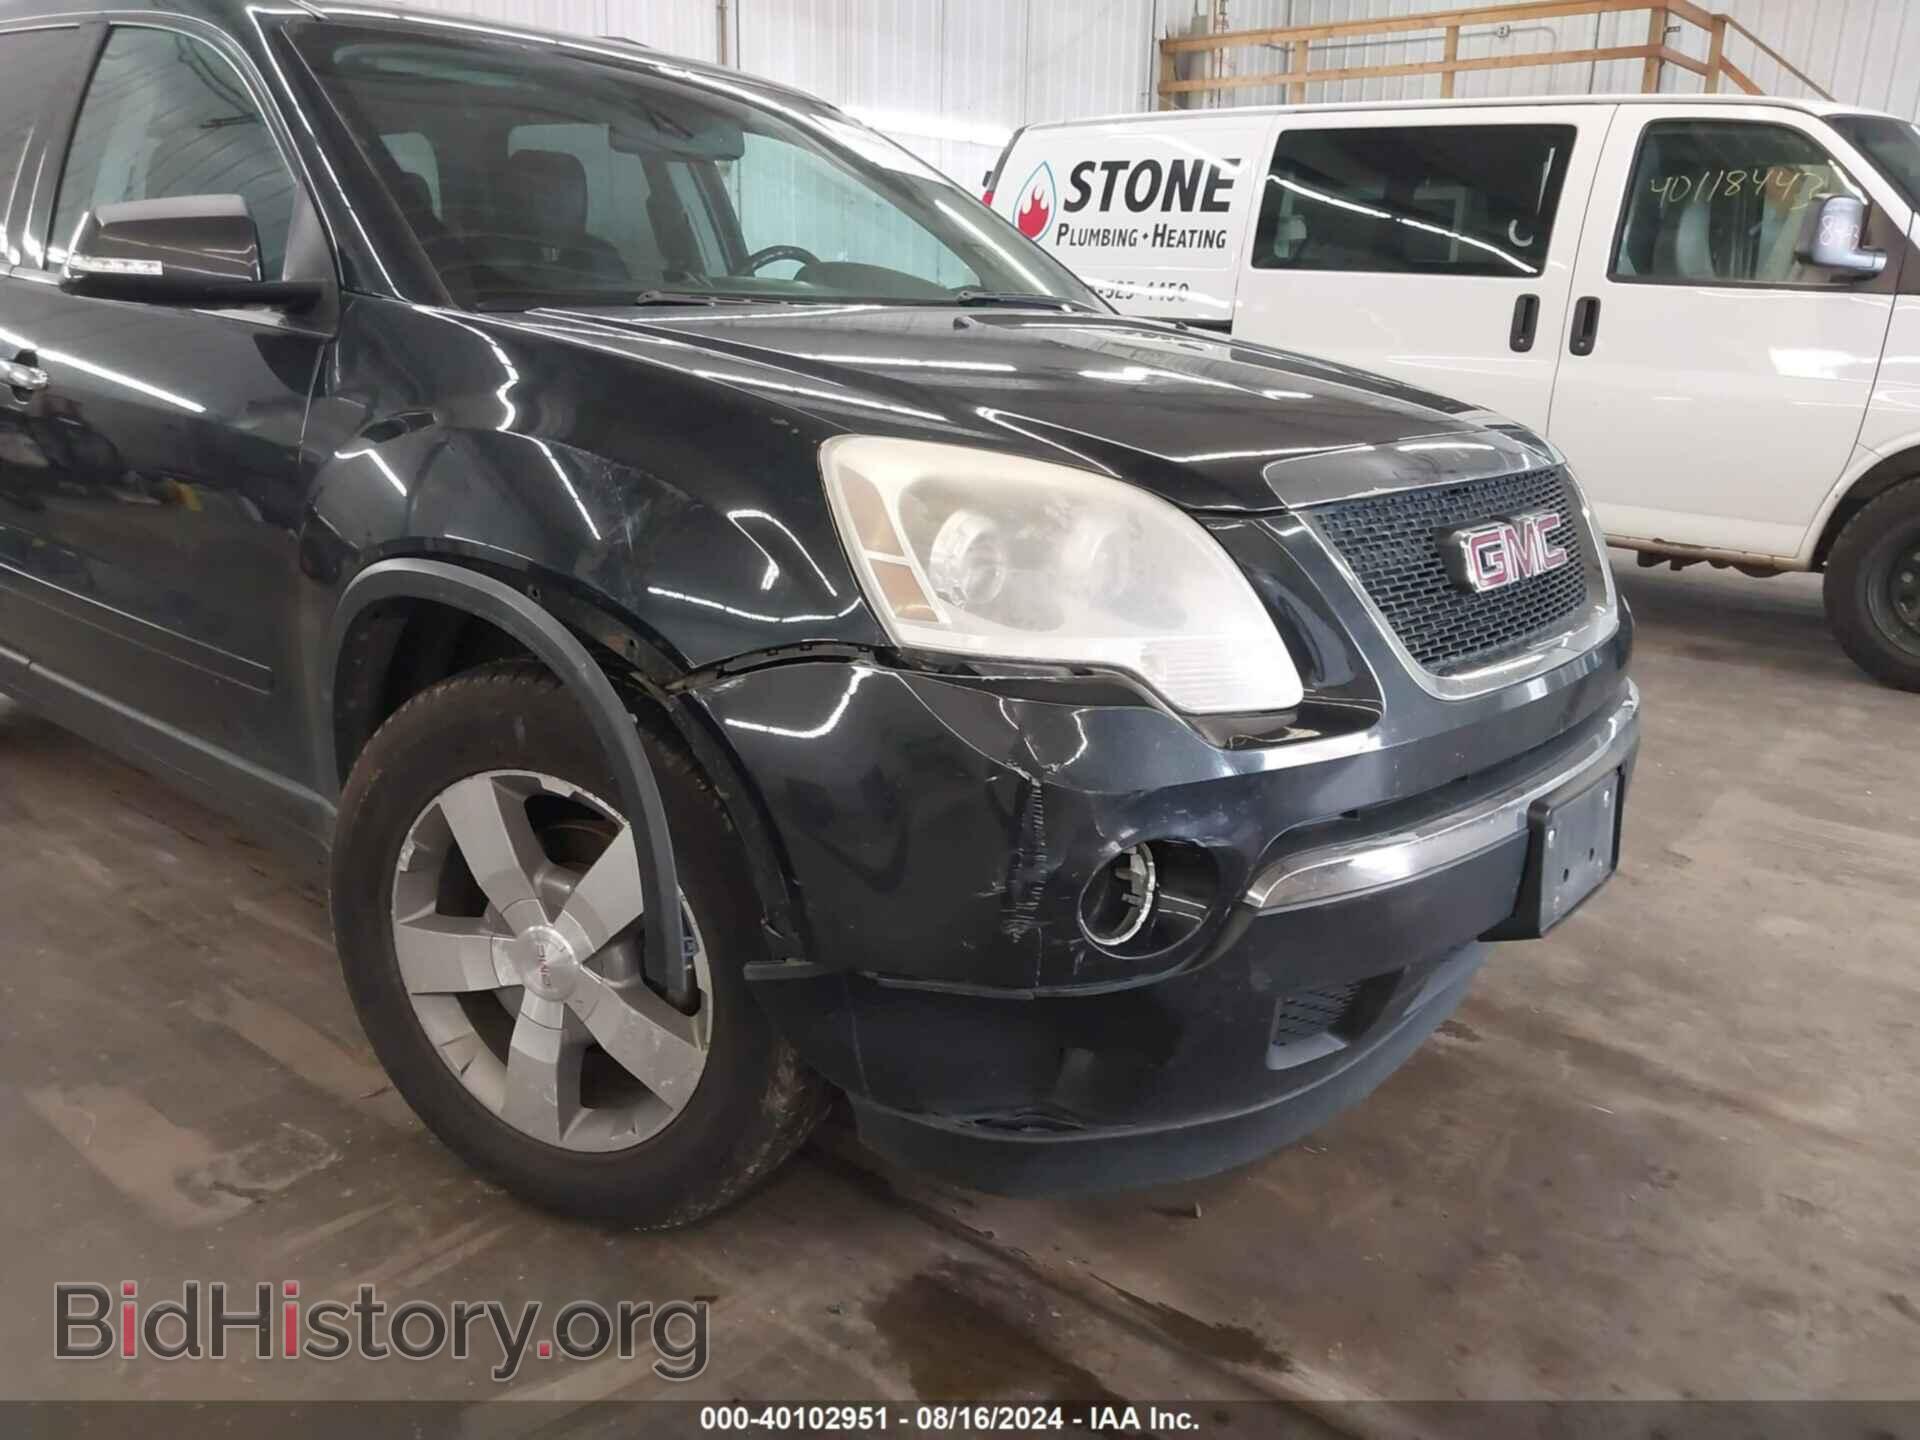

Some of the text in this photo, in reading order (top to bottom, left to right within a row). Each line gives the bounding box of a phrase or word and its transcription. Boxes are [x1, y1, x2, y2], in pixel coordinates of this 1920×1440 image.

[1063, 158, 1241, 213] STONE
[1056, 223, 1227, 249] PLUMBING HEATING
[1462, 513, 1568, 593] GMC
